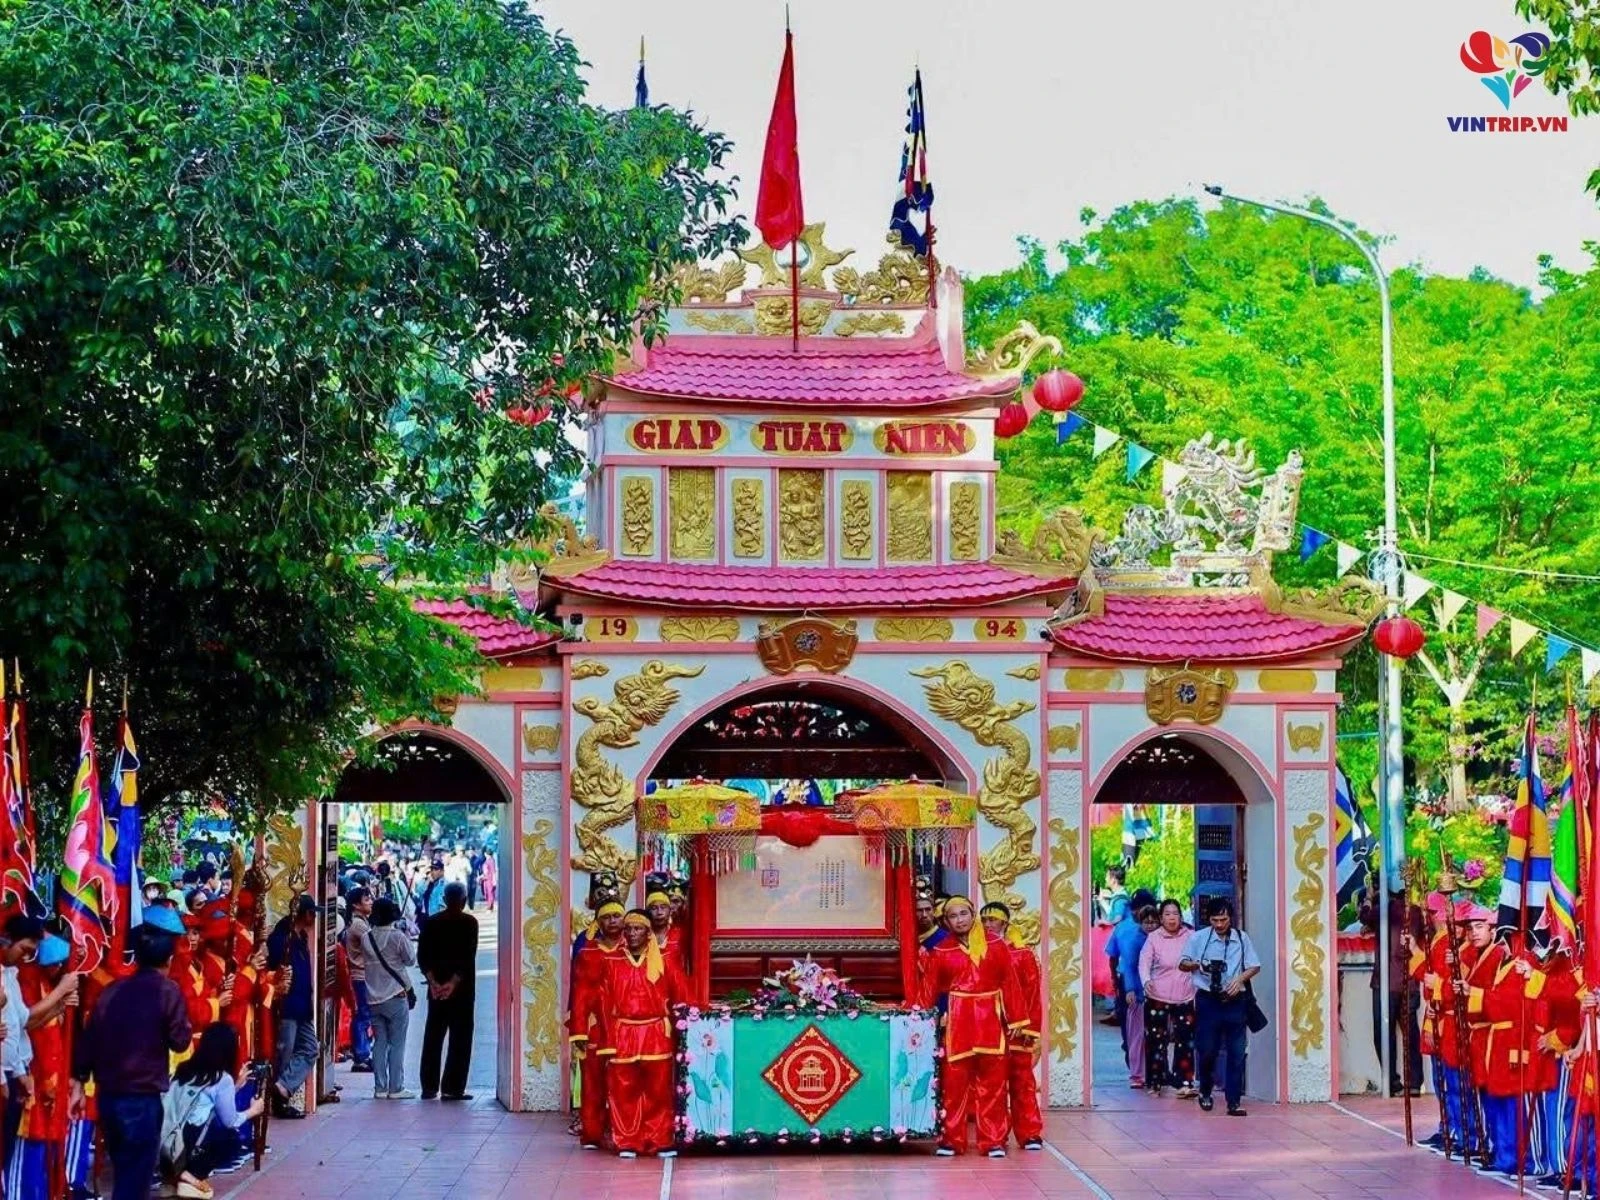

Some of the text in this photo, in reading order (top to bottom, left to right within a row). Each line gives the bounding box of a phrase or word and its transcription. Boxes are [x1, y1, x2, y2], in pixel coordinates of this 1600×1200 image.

[633, 419, 722, 450] GIAP
[884, 422, 967, 454] NIEN
[599, 618, 1018, 638] 19 94
